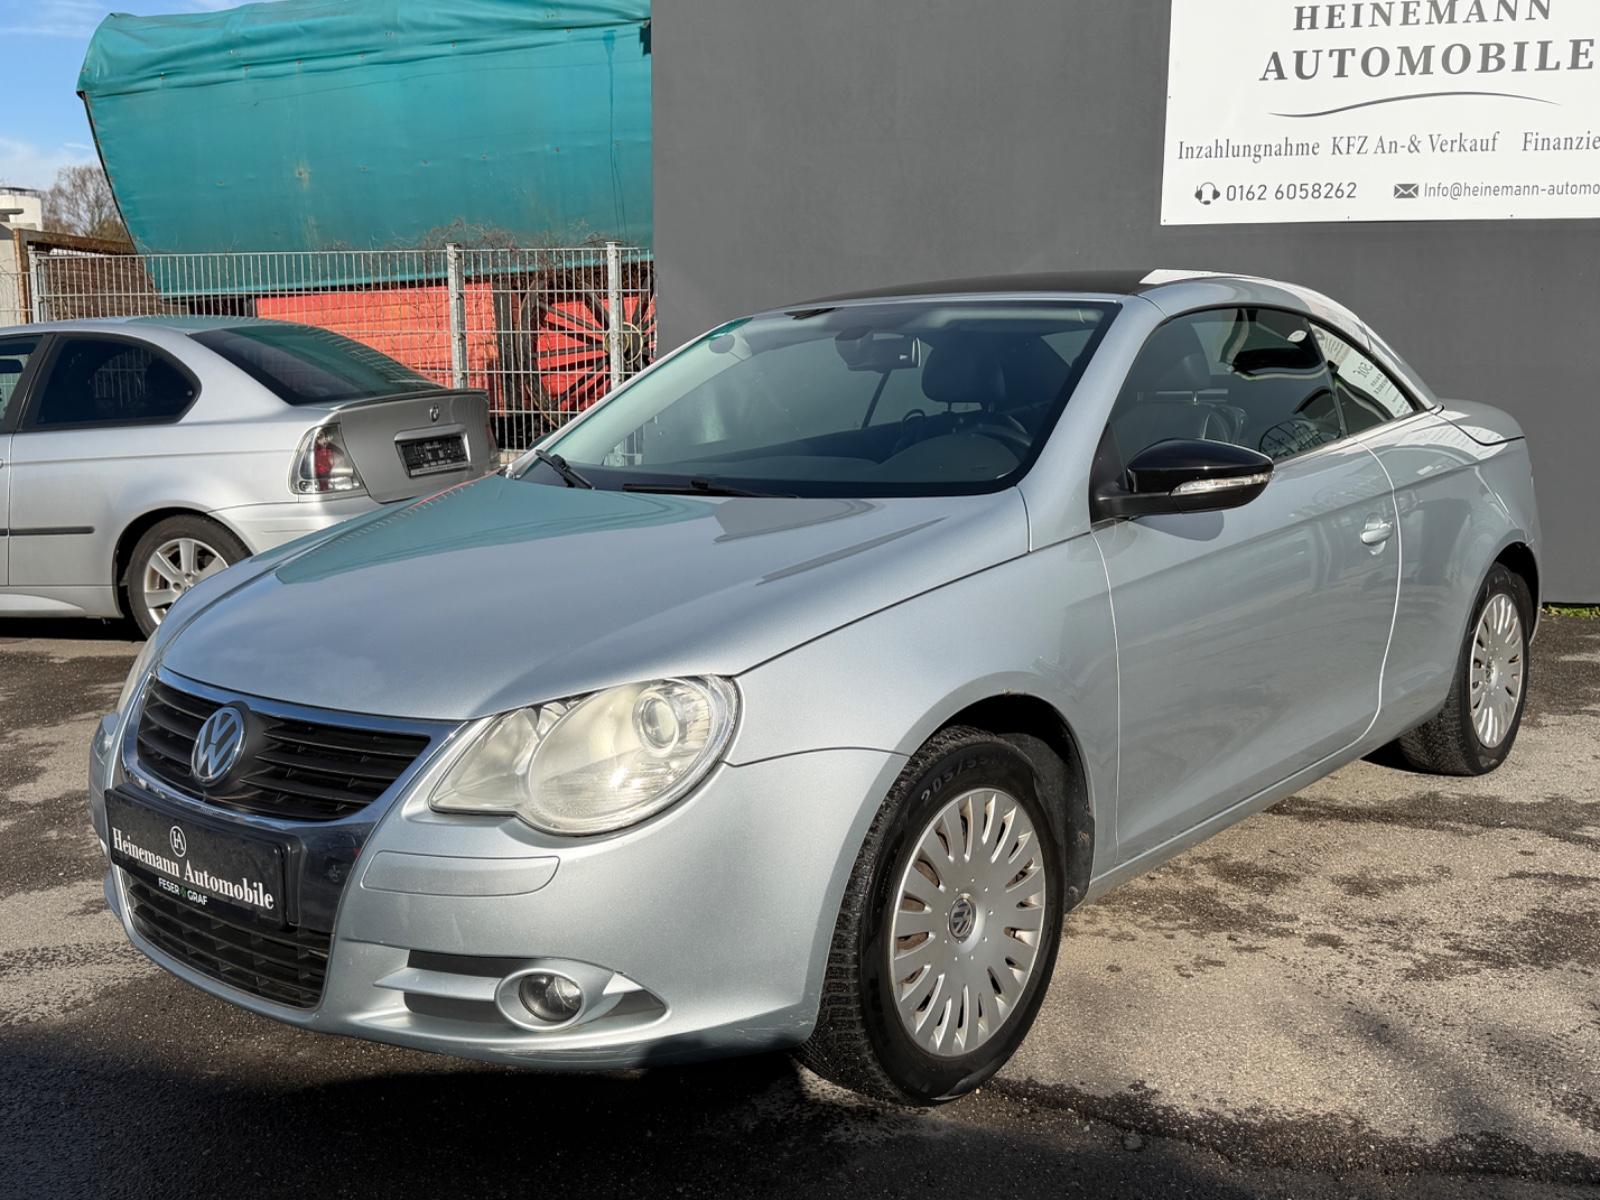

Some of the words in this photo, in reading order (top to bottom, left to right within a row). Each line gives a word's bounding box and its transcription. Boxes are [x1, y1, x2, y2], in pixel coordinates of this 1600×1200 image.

[1293, 0, 1552, 31] HEINEMANN
[1258, 38, 1595, 81] AUTOMOBILE
[1178, 137, 1320, 164] Inzahlungnahme
[1331, 135, 1369, 156] KFZ
[1428, 131, 1500, 153] Verkauf
[1522, 130, 1600, 151] Finanzie
[1226, 184, 1267, 201] 0162
[1274, 181, 1357, 200] 6058262
[1424, 180, 1600, 200] Info@heinemann-automo
[111, 827, 181, 878] Heinemann
[184, 859, 275, 910] Automobile
[158, 876, 181, 896] FESER
[187, 889, 208, 906] GRAF
